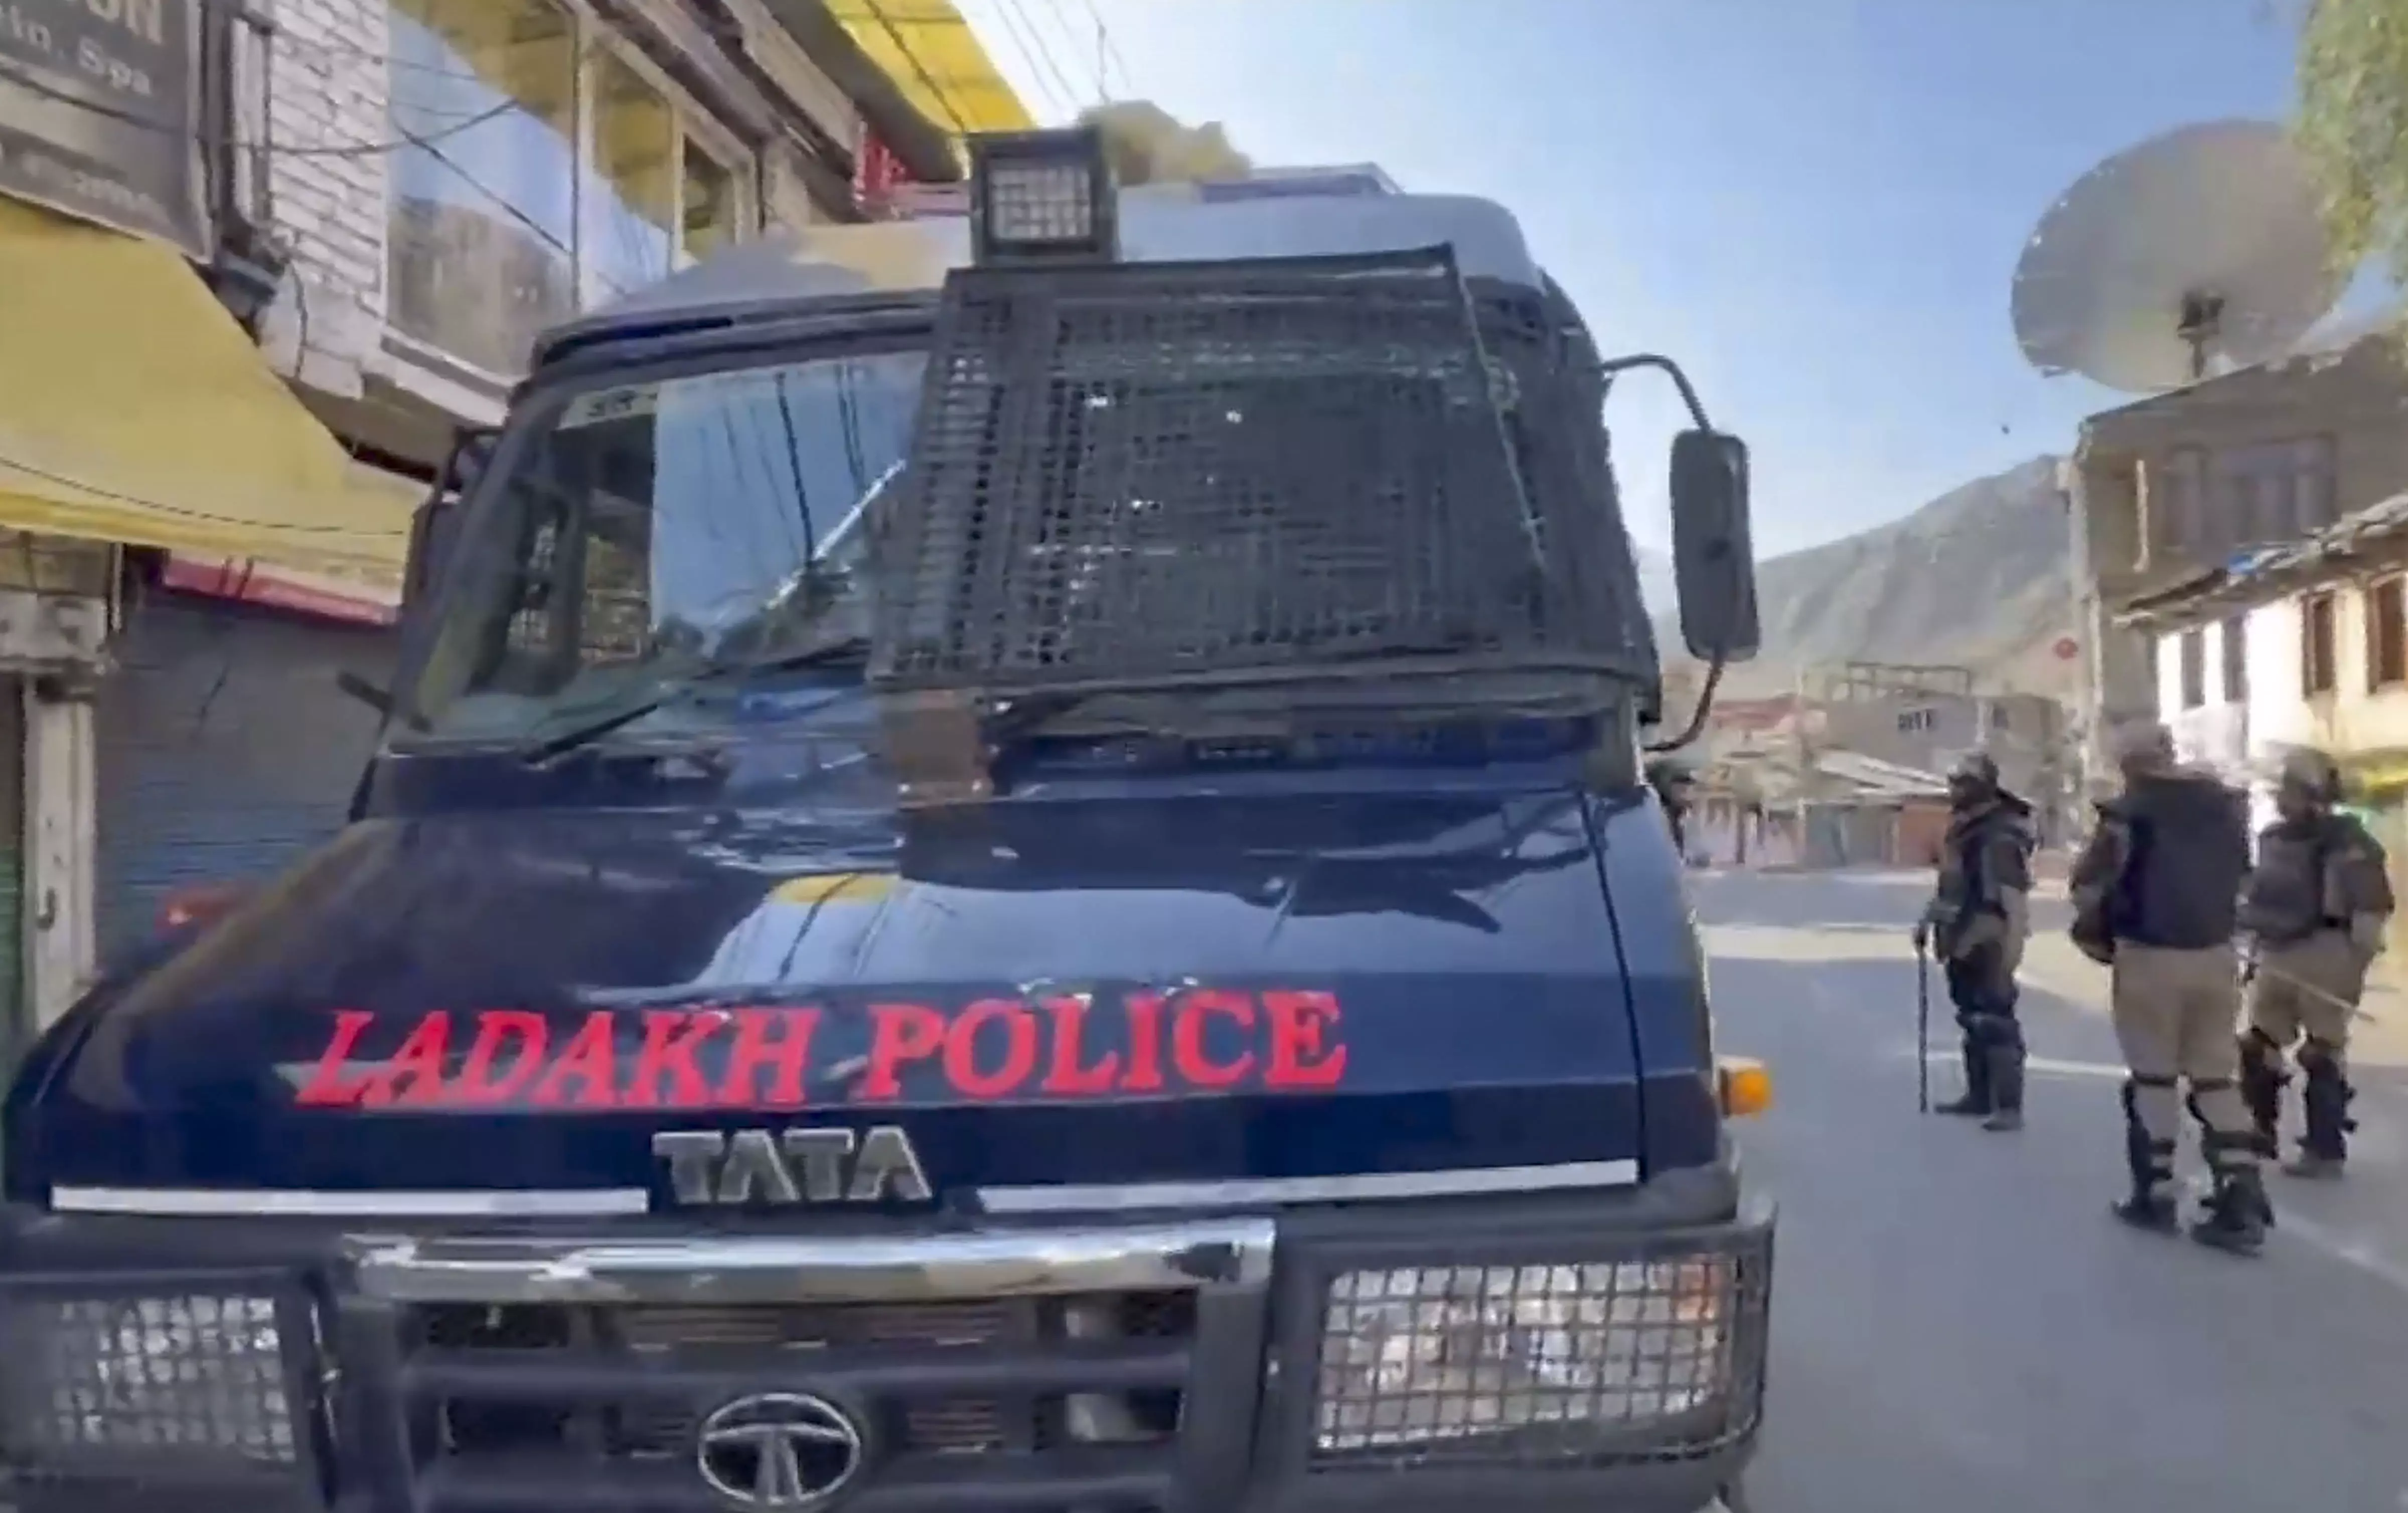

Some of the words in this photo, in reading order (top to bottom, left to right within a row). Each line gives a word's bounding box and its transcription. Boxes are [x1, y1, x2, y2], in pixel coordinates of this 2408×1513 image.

[296, 1010, 819, 1108] LADAKH
[862, 991, 1346, 1100] POLICE
[652, 1127, 932, 1203] TATA
